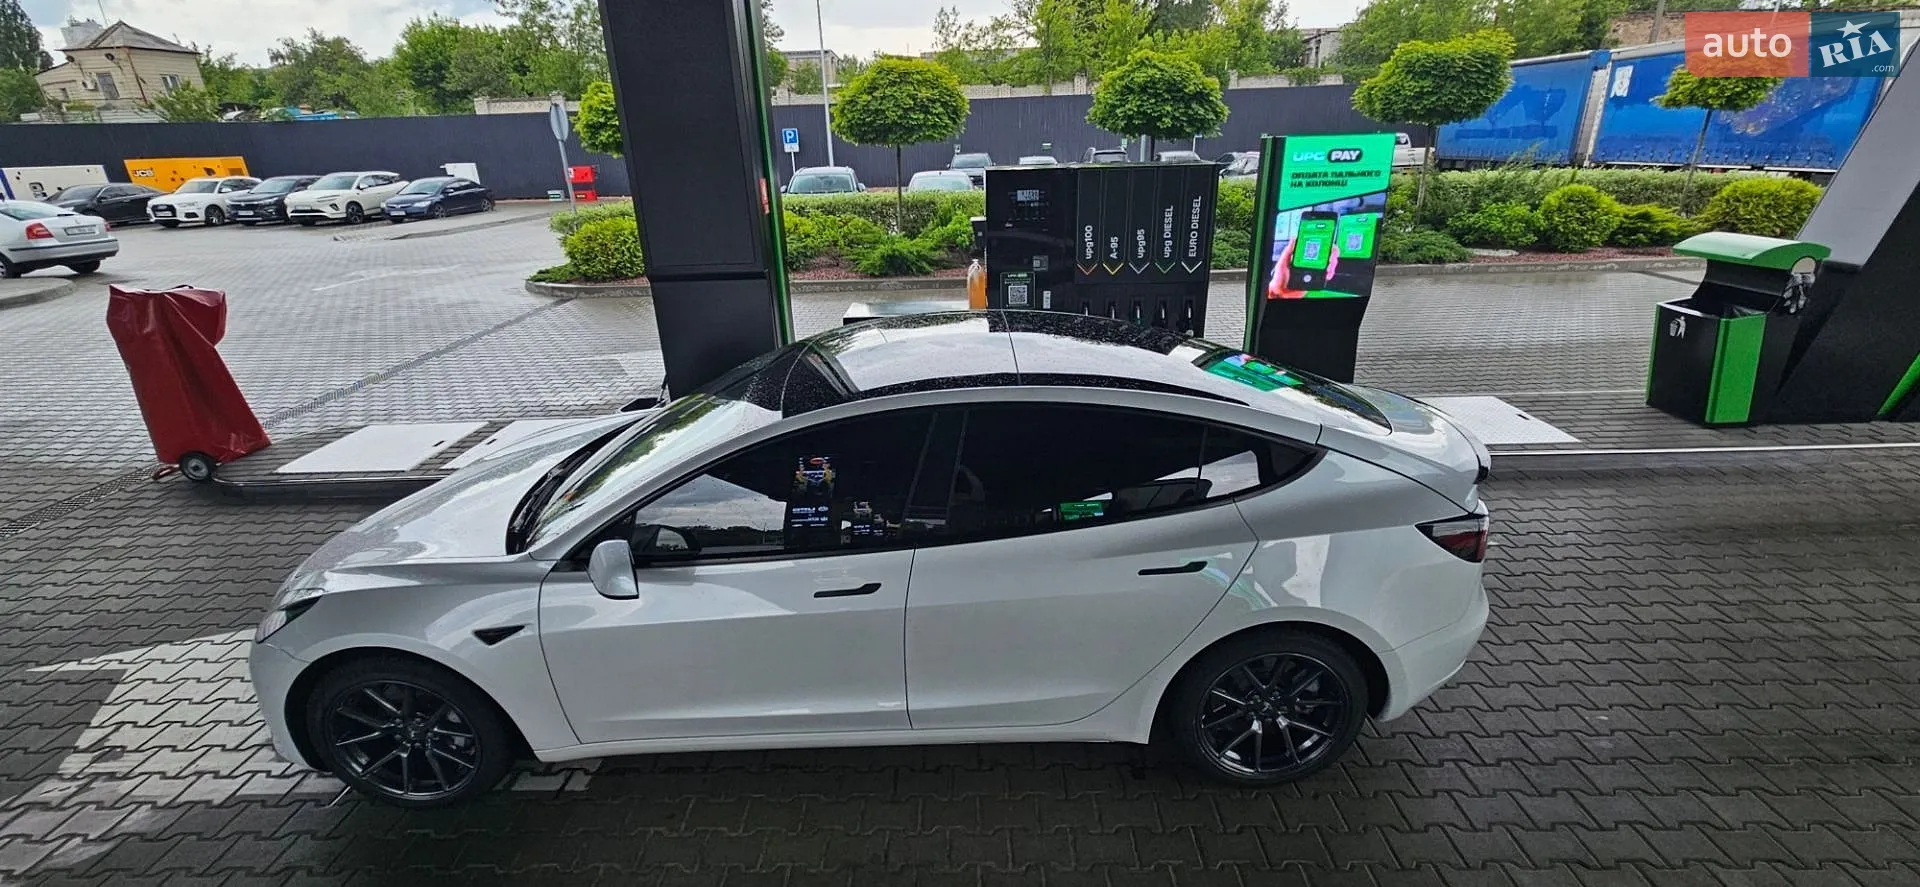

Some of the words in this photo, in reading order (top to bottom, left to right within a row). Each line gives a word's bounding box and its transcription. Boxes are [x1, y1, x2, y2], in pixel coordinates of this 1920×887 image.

[786, 130, 794, 143] P
[1331, 150, 1360, 161] PAY
[133, 167, 154, 177] JCB
[1163, 205, 1173, 238] DIESEL
[1190, 196, 1202, 229] DIESEL
[1084, 225, 1094, 260] upg100
[1110, 236, 1119, 260] A-95
[1136, 229, 1146, 259] upg95
[1163, 240, 1172, 258] upg
[1188, 230, 1199, 257] EURO
